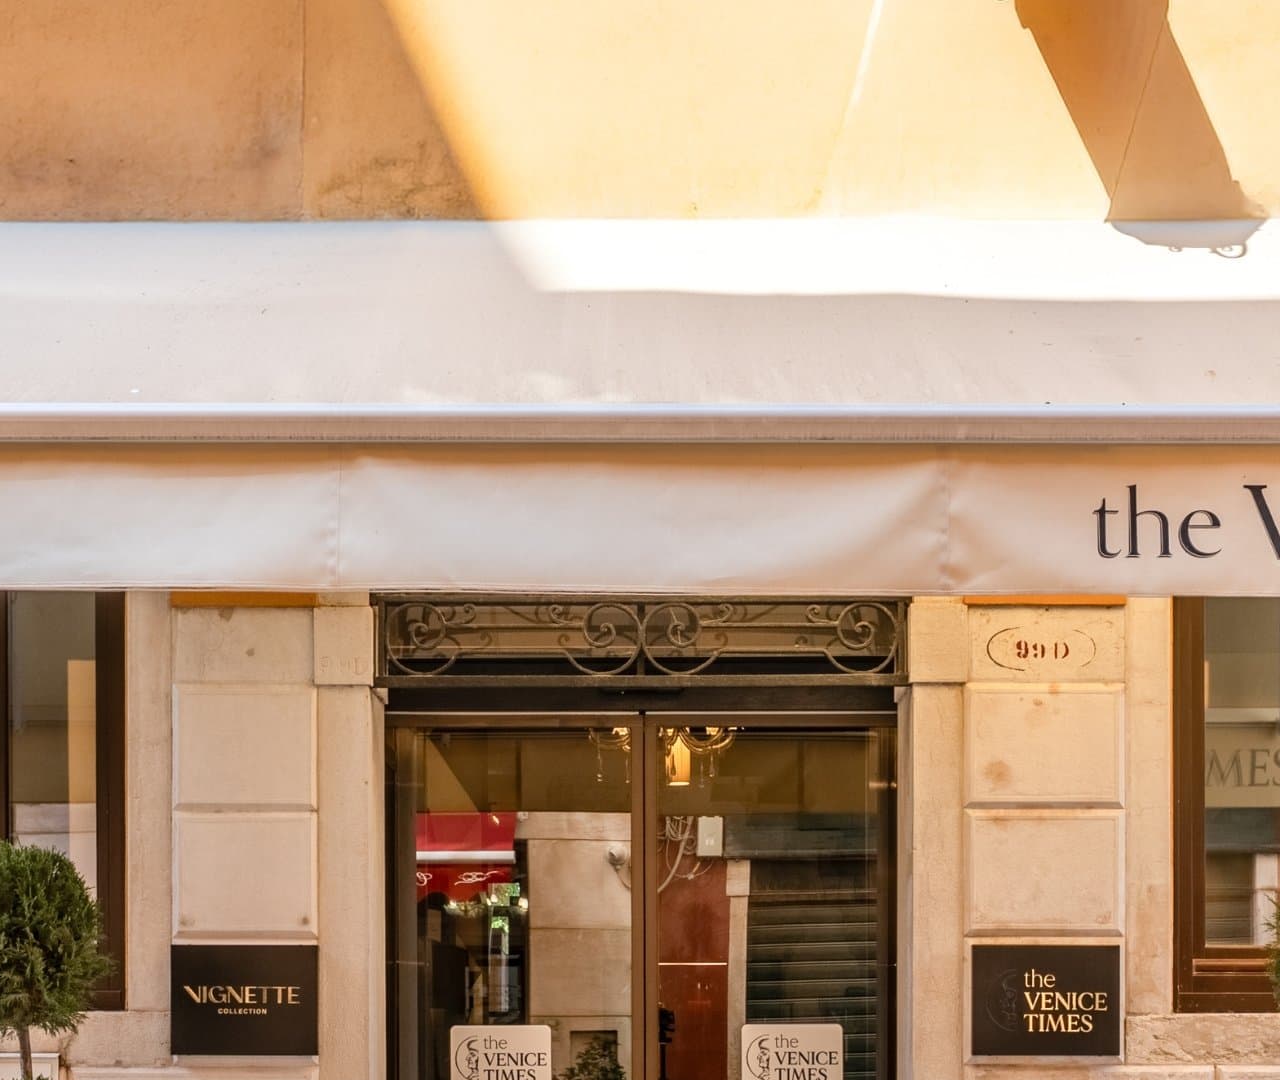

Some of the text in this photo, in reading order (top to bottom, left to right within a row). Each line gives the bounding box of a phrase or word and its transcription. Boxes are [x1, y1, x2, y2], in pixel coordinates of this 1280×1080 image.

[1092, 484, 1222, 560] the
[1024, 969, 1056, 988] the
[183, 985, 302, 1004] VIGNETTE
[1024, 992, 1108, 1011] VENICE
[217, 1007, 268, 1015] COLLECTION
[1023, 1013, 1094, 1033] TIMES
[483, 1035, 508, 1051] the
[774, 1033, 799, 1049] the
[483, 1052, 548, 1067] VENICE
[774, 1050, 839, 1066] VENICE
